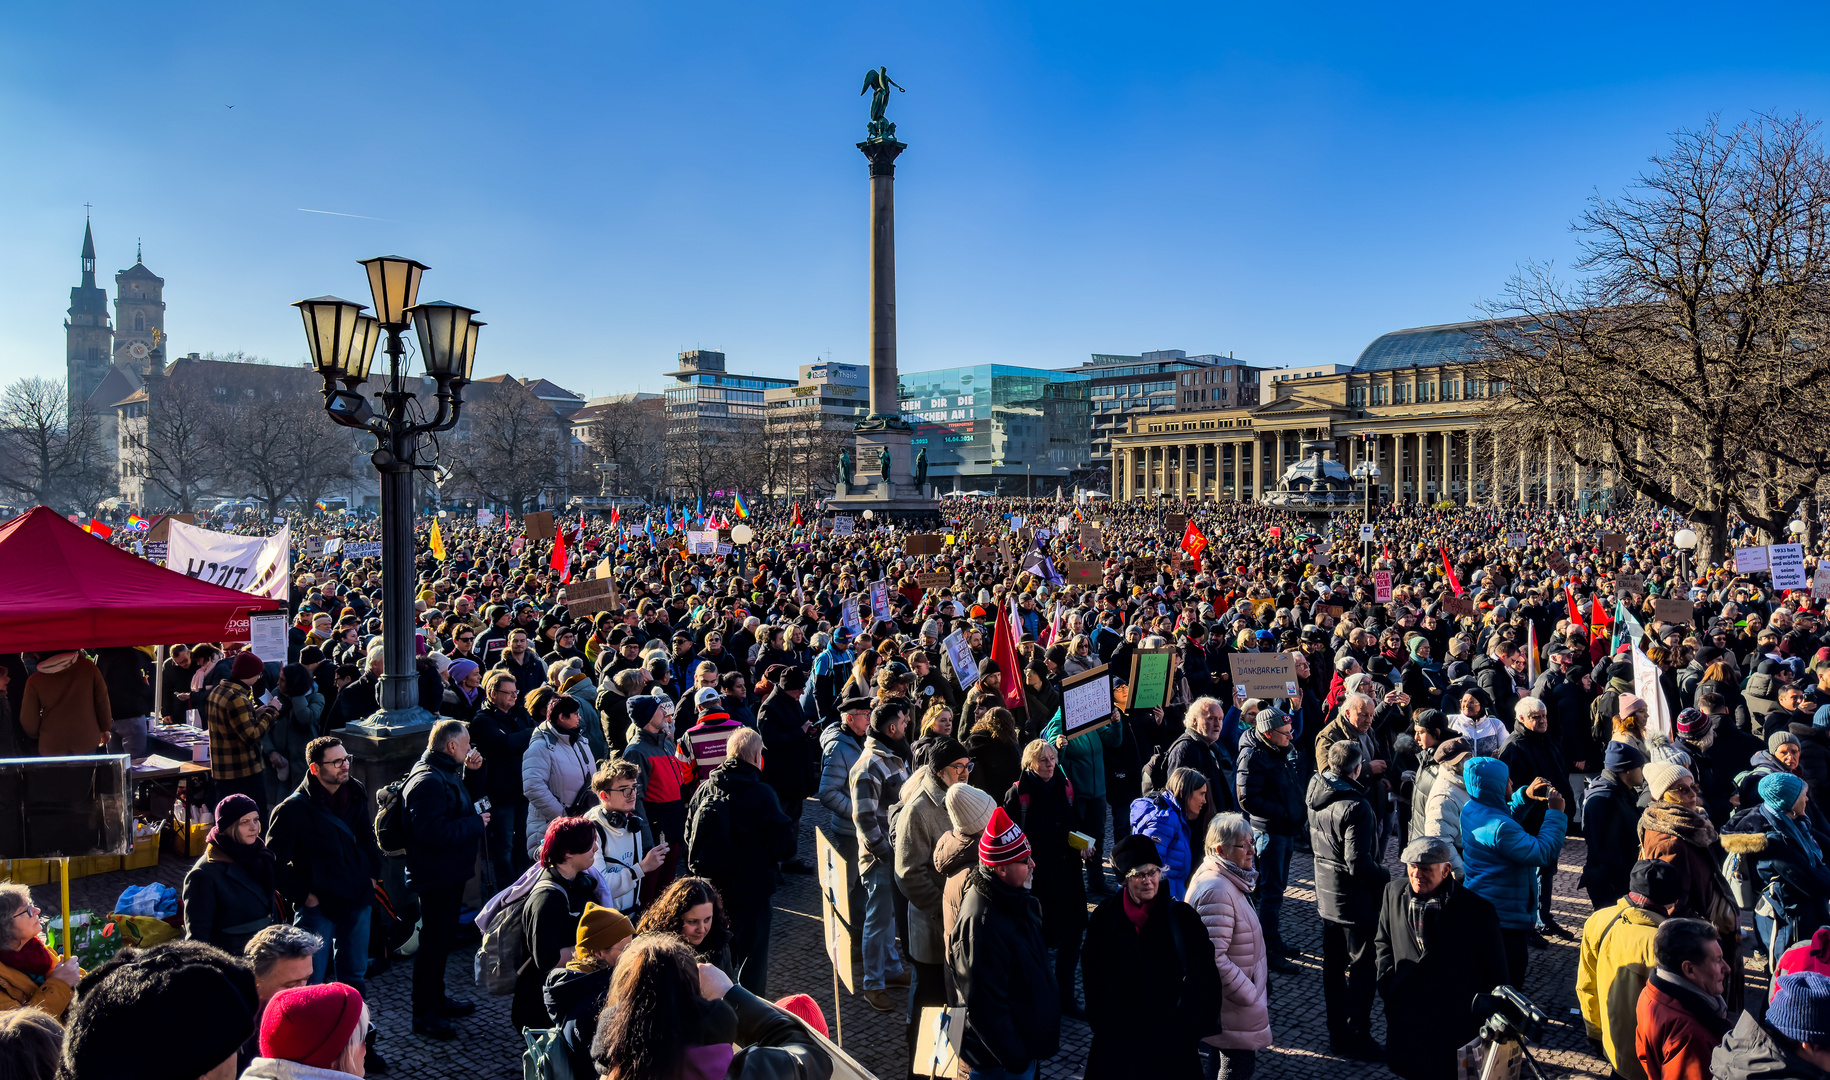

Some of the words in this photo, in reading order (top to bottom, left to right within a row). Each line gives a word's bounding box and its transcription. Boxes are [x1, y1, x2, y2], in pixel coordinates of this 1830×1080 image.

[900, 399, 921, 411] SIEH
[930, 397, 947, 409] DIR
[957, 395, 974, 406] DIE
[901, 410, 947, 423] MENSCHEN
[951, 408, 965, 420] AN
[944, 435, 974, 443] 14.04.2024
[229, 619, 249, 628] DGB
[1237, 657, 1255, 665] Mehr
[1237, 666, 1289, 676] DANKBARKEIT
[1065, 680, 1102, 700] HINSEHEN
[1066, 687, 1106, 711] AUFSTEHEN
[1066, 694, 1108, 719] DEMOKRATIE
[1066, 702, 1110, 728] VERTEIDIGEN
